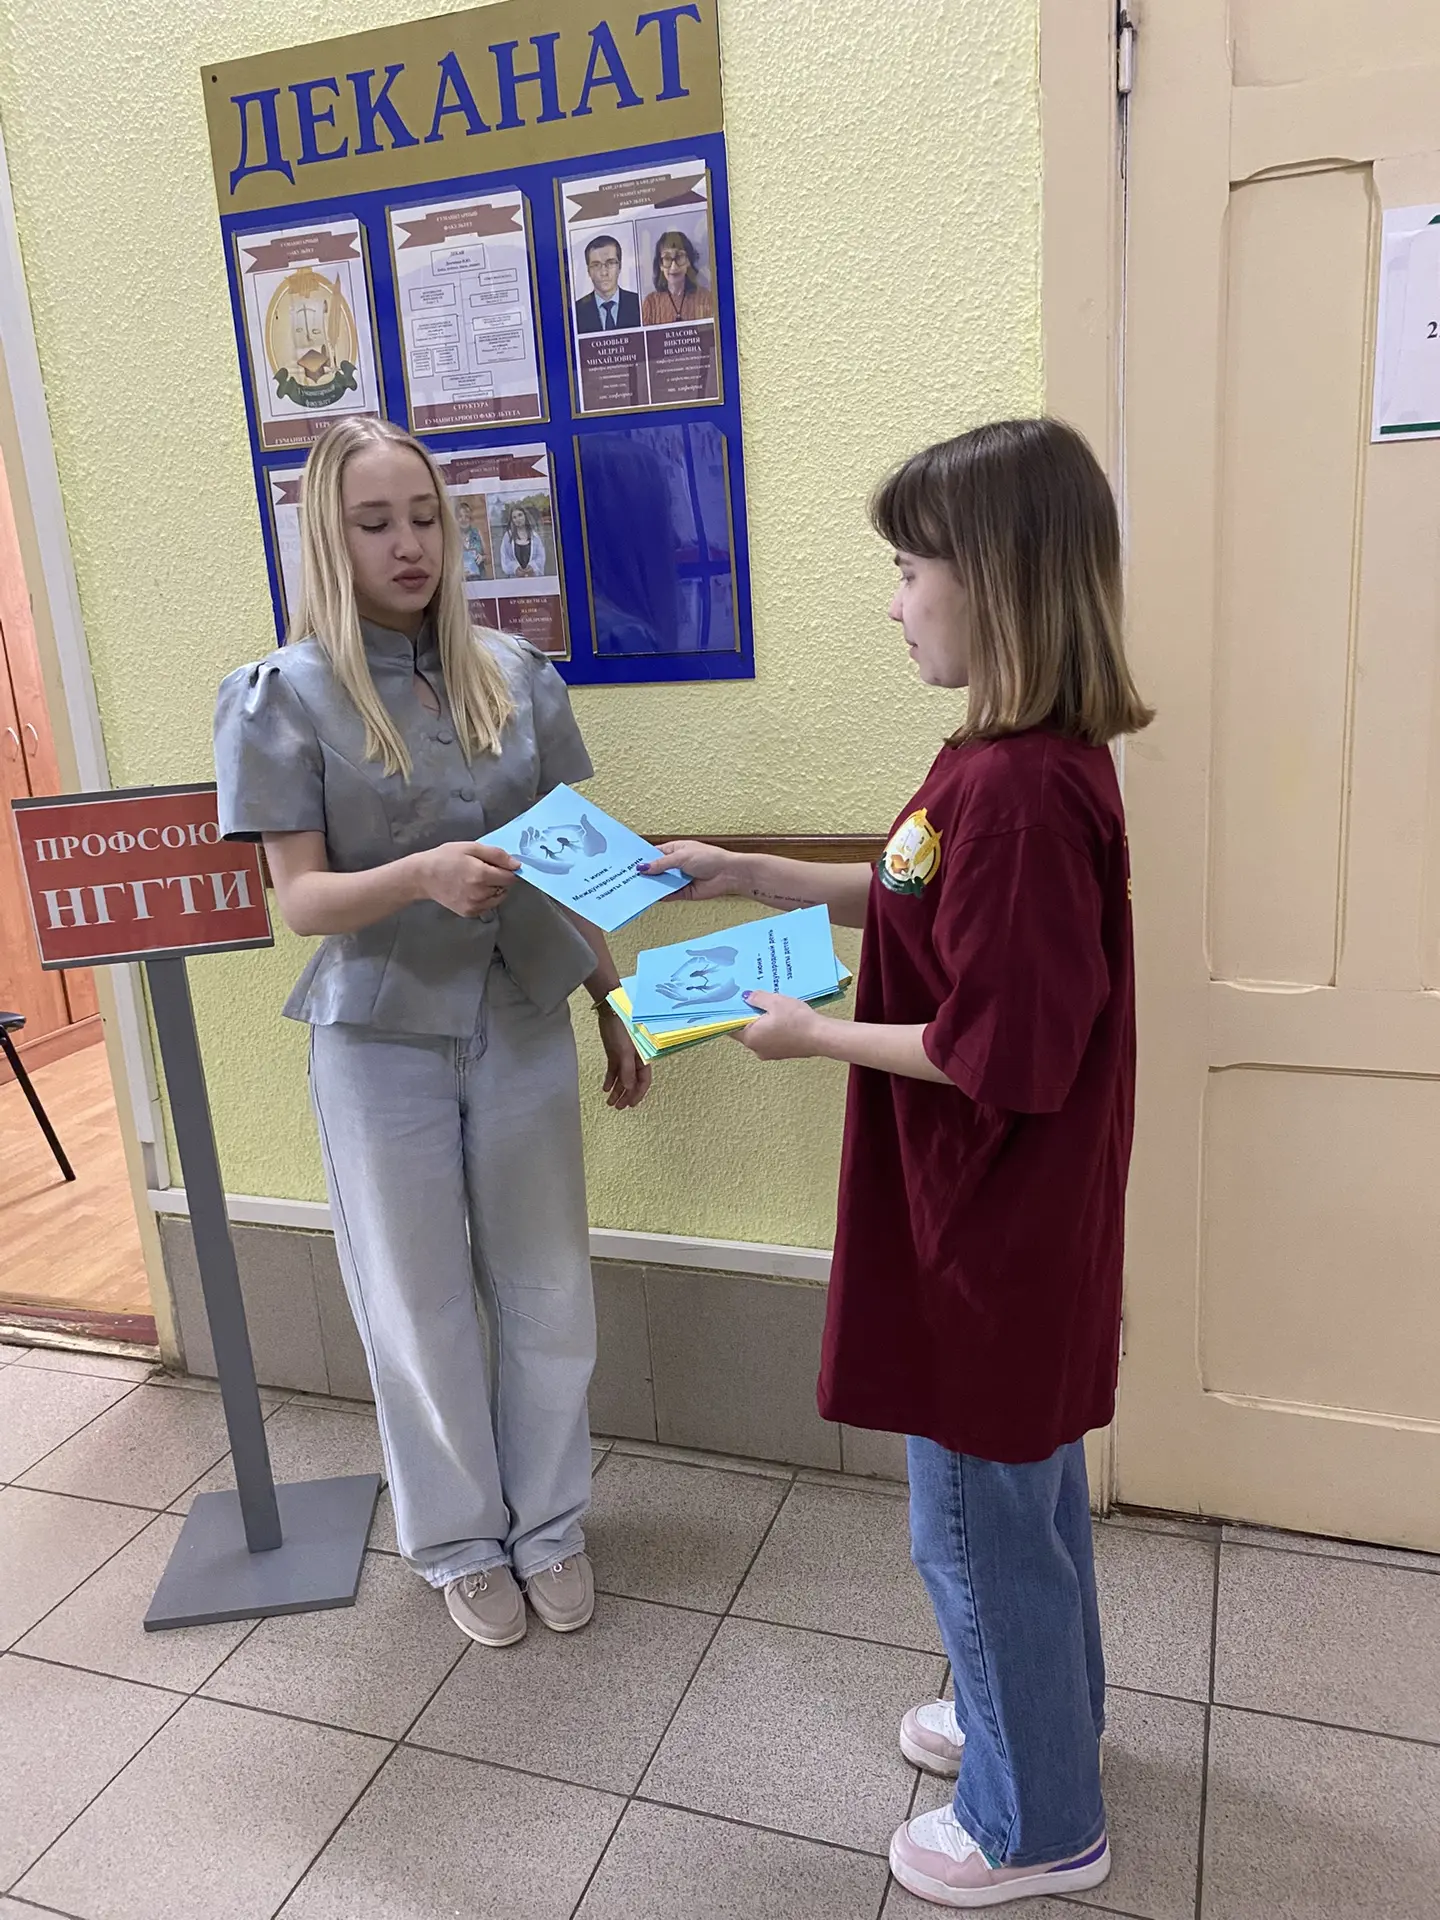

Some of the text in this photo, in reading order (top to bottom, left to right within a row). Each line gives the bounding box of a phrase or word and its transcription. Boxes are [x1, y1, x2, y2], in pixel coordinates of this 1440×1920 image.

[229, 4, 702, 196] ДЕКАНАТ
[665, 329, 698, 339] ВЛАСОВА
[591, 337, 629, 348] СОЛОВЬЕВ
[663, 337, 701, 348] ВИКТОРИЯ
[597, 345, 625, 357] АНДРЕЙ
[663, 345, 702, 356] ИВАНОВНА
[586, 354, 637, 366] МИХАЙЛОВИЧ
[453, 401, 489, 411] СТРУКТУРА
[424, 410, 521, 425] ГУМАНИТАРНОГО ФАКУЛЬТЕТА
[33, 821, 222, 862] ПРОФСОЮ
[572, 857, 644, 901] Международный день
[590, 868, 609, 880] июня
[596, 884, 623, 901] защиты
[39, 869, 256, 930] НГГТИ
[768, 929, 780, 994] еждународный день
[782, 937, 793, 980] защиты детей
